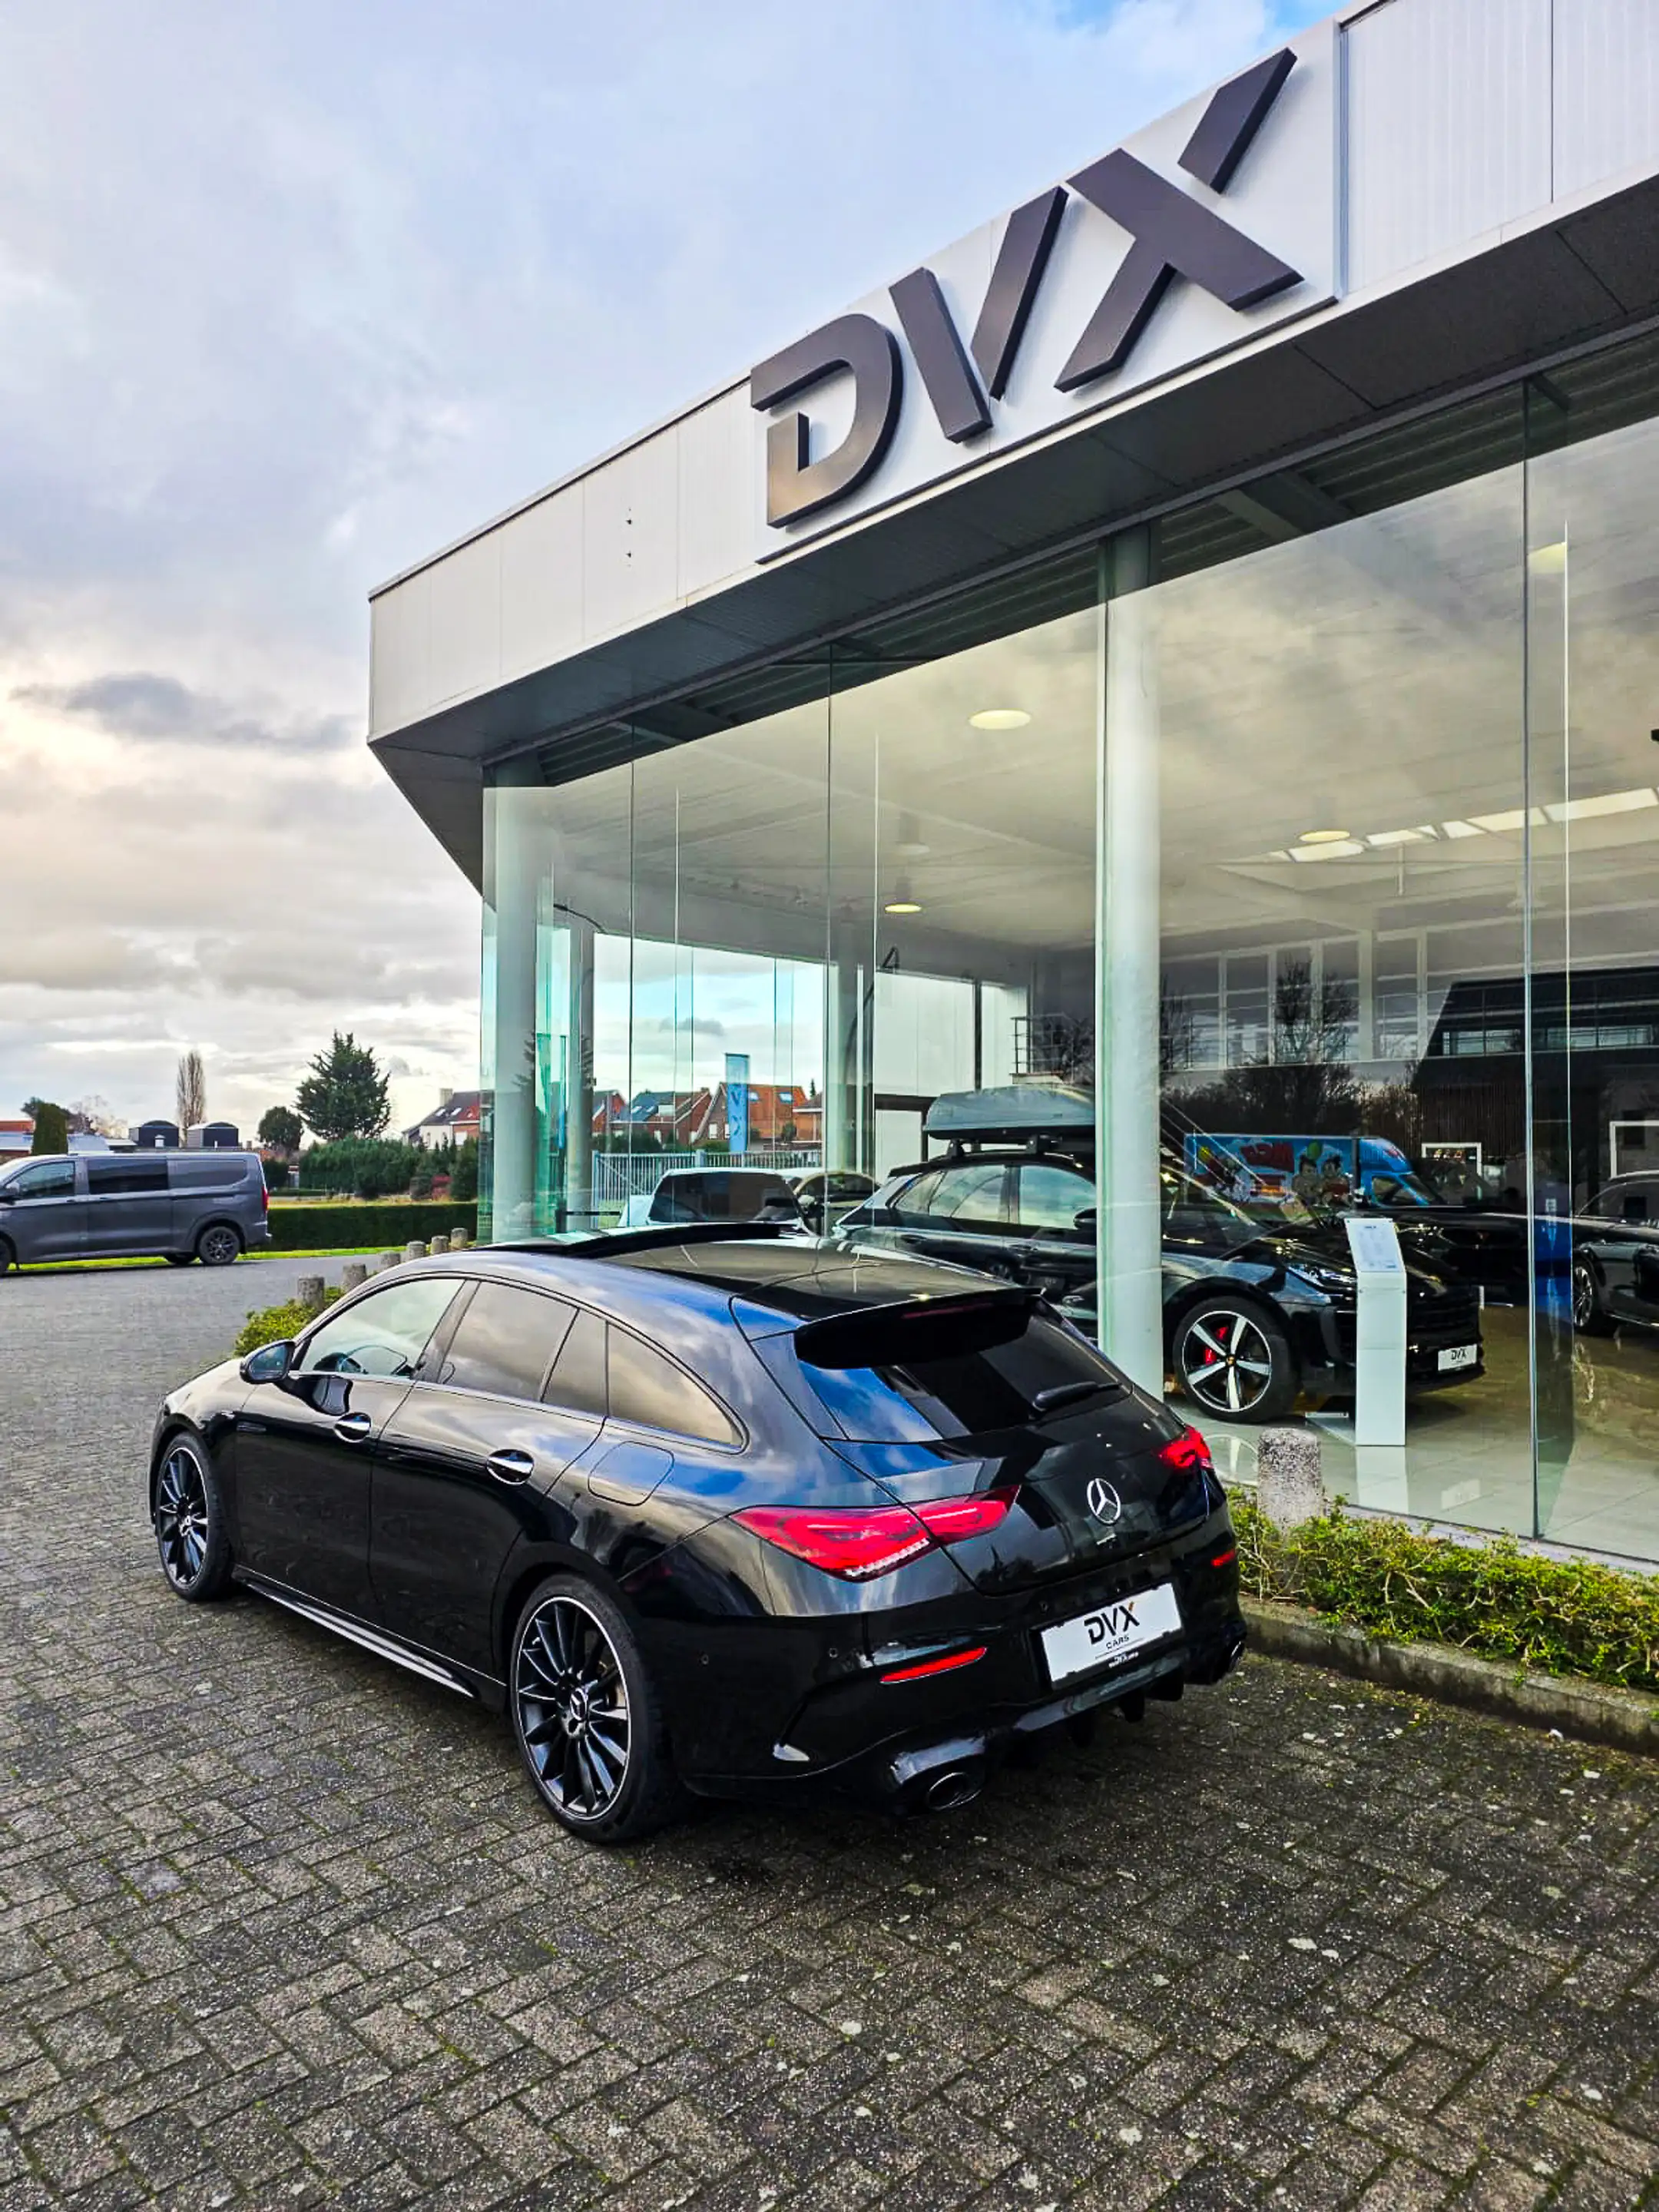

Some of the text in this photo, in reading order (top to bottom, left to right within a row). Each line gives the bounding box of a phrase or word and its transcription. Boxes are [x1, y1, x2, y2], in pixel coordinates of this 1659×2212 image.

[750, 47, 1305, 529] DVX
[1084, 1601, 1140, 1645] DVX
[1106, 1635, 1129, 1649] CARS
